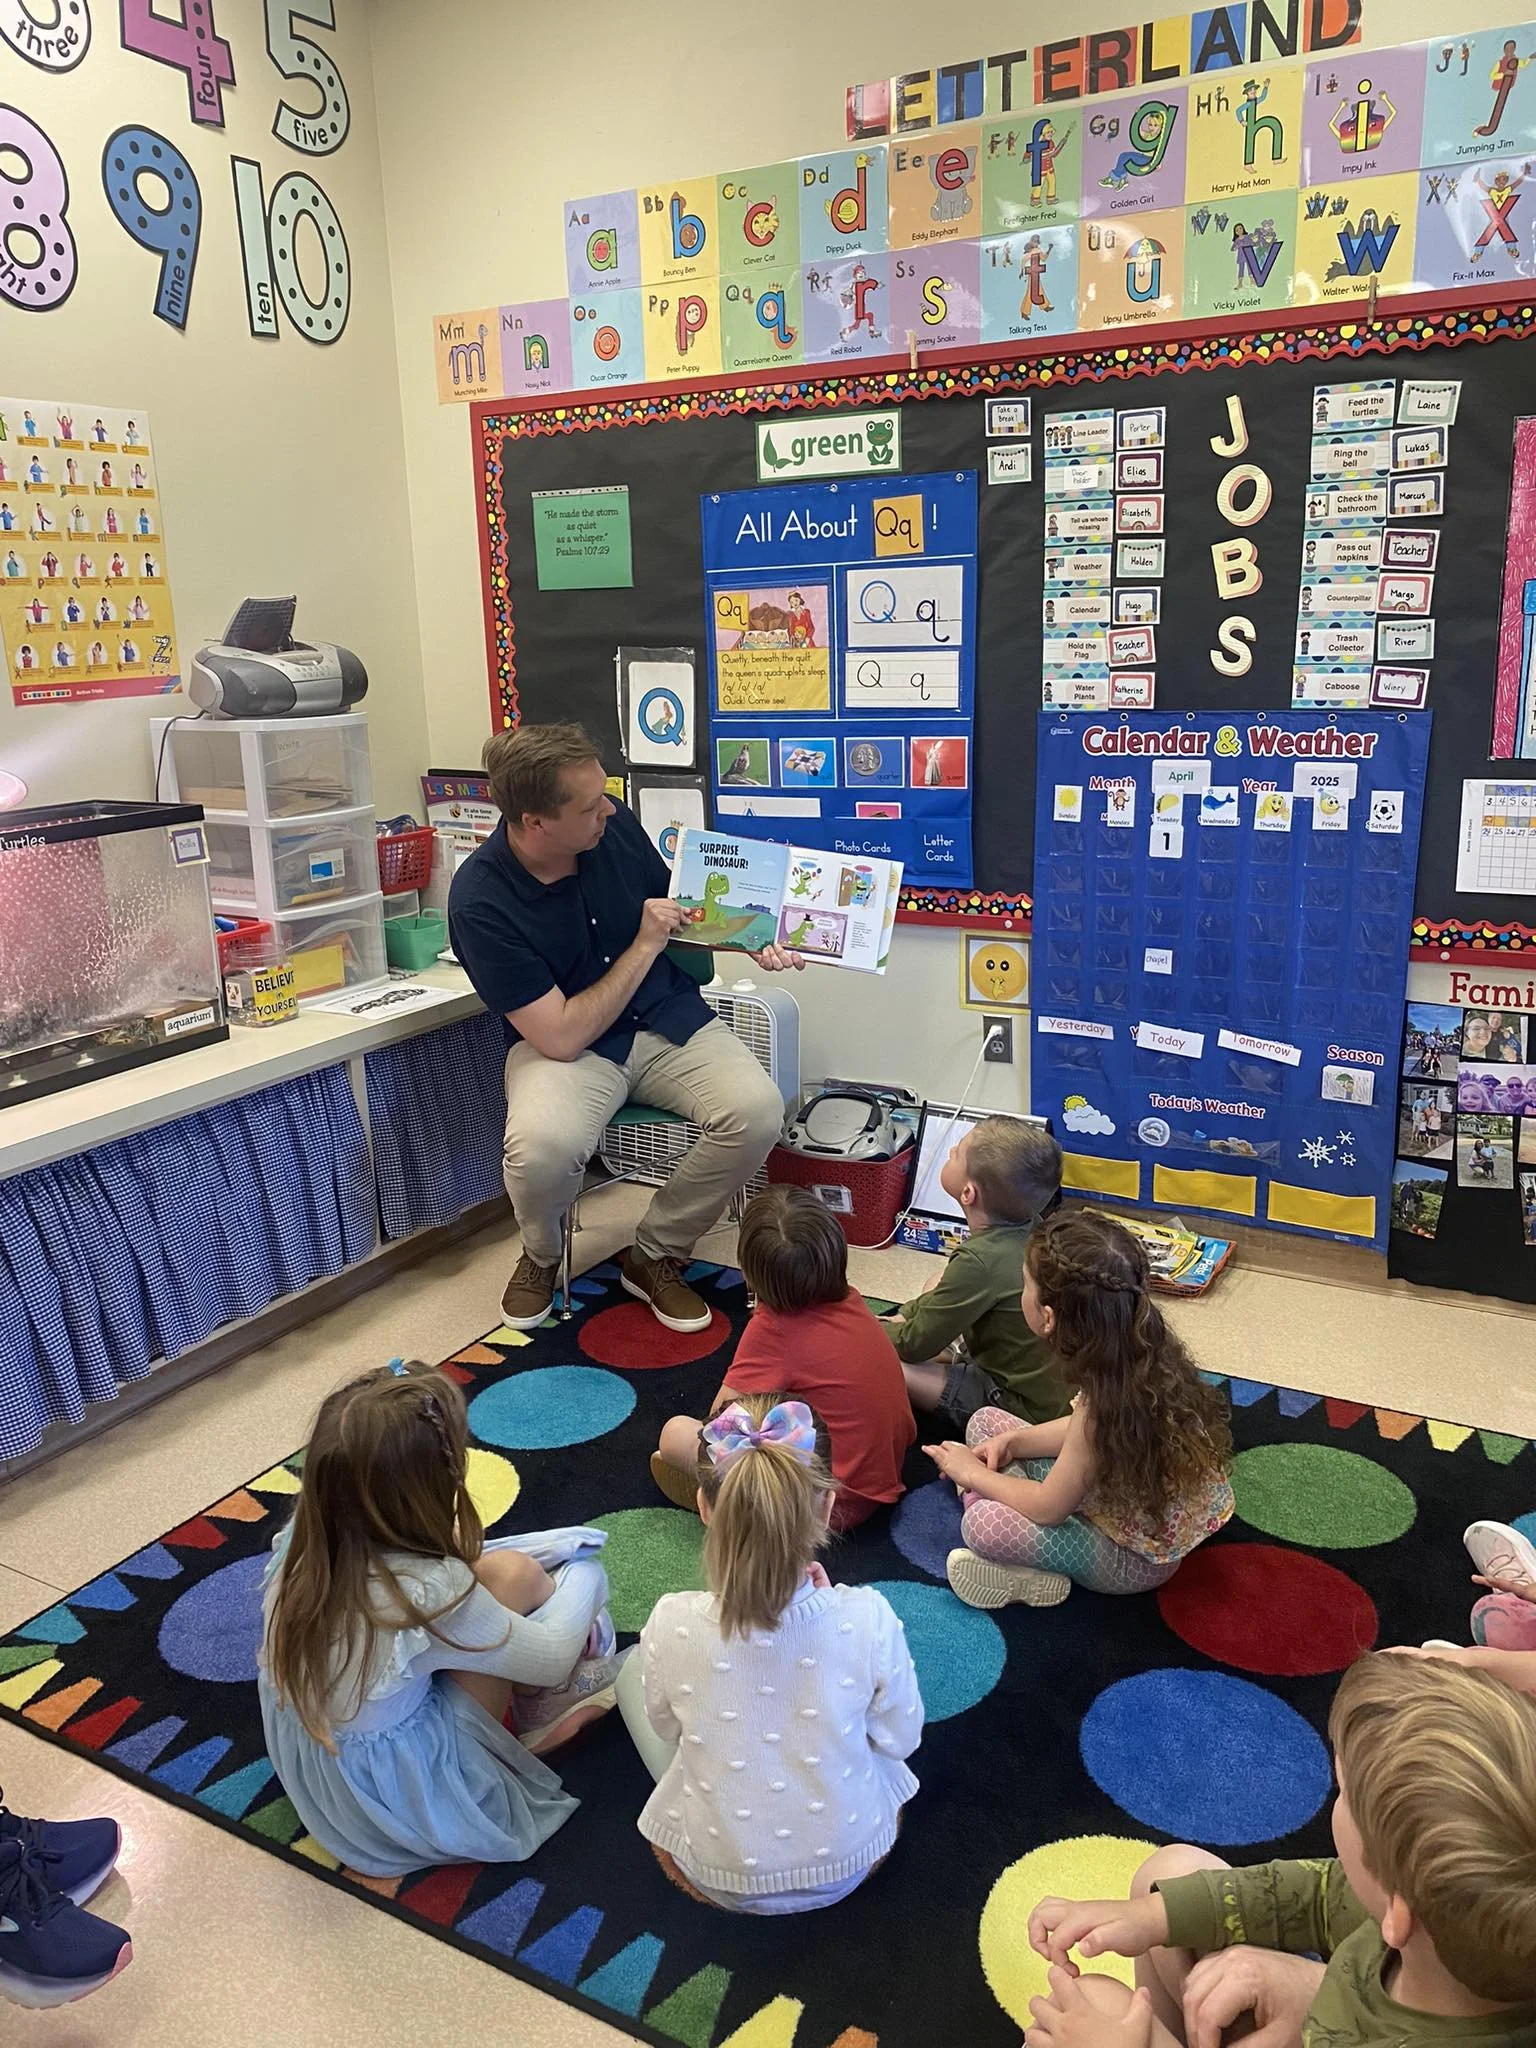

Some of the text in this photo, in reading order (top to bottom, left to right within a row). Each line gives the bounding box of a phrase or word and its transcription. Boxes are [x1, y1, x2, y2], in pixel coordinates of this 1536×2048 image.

[16, 19, 79, 59] three
[851, 0, 1362, 141] LETTERLAND
[197, 47, 216, 107] four
[294, 118, 328, 147] five
[1456, 139, 1514, 155] Jumping Jim
[1342, 160, 1377, 174] Impy Ink
[1212, 177, 1271, 193] Harry Hat Man
[1110, 195, 1155, 209] Golden Girl
[1040, 210, 1057, 220] Fred
[101, 124, 202, 332] 9
[912, 227, 958, 241] Eddy Elephant
[230, 154, 351, 346] 10
[826, 242, 862, 254] Dippy Duck
[743, 255, 775, 265] Clever Cat
[1452, 269, 1496, 282] Fix-it Max
[165, 265, 185, 317] nine
[1322, 288, 1349, 297] Walter
[257, 281, 272, 324] ten
[1213, 298, 1261, 312] Vicky Violet
[1103, 309, 1157, 325] Uppy Umbrella
[1009, 323, 1048, 336] Talking Tess
[936, 335, 957, 344] Snake
[831, 345, 862, 356] Red Robot
[772, 354, 793, 363] Queen
[607, 371, 628, 381] Orange
[1348, 398, 1368, 407] Feed
[1417, 400, 1440, 410] Laine
[1352, 408, 1379, 417] turtles
[1073, 427, 1108, 438] Line Leader
[1129, 423, 1150, 433] Porter
[791, 432, 863, 467] green
[1405, 443, 1429, 453] Lukas
[1334, 450, 1352, 459] Ring
[999, 460, 1017, 471] Andi
[1126, 465, 1146, 475] Elias
[1342, 460, 1357, 468] bell
[1337, 494, 1378, 503] Check the
[1399, 492, 1425, 500] Marcus
[559, 508, 618, 518] made the storm
[1121, 508, 1151, 517] Elizabeth
[1337, 504, 1377, 513] bathroom
[577, 521, 597, 533] quiet
[735, 511, 772, 545] All
[780, 504, 858, 543] About
[875, 507, 920, 549] Qq
[556, 547, 583, 557] Psalms
[1336, 543, 1355, 551] Pass
[1392, 542, 1427, 556] Teacher
[1130, 556, 1153, 566] Holden
[1337, 554, 1369, 562] napkins
[1074, 563, 1102, 571] Weather
[1326, 594, 1371, 602] Counterpillar
[1391, 589, 1415, 600] Margo
[860, 580, 896, 623] Q
[1125, 600, 1141, 613] Hugo
[717, 596, 747, 627] Qq
[1068, 642, 1096, 650] Hold the
[1114, 640, 1145, 651] Teacher
[1394, 637, 1416, 646] River
[1328, 644, 1364, 652] Collector
[752, 651, 794, 663] beneath the
[1074, 652, 1089, 660] Flag
[764, 666, 805, 681] quadruplets
[857, 660, 884, 689] Q
[1325, 682, 1360, 690] Caboose
[747, 695, 770, 705] Come
[1083, 724, 1376, 757] Calendar & Weather
[1089, 776, 1135, 790] Month
[1168, 771, 1194, 783] April
[1310, 776, 1339, 786] 2025
[426, 783, 454, 797] LOS
[1242, 778, 1276, 793] Year
[1156, 816, 1179, 824] Tuesday
[1202, 817, 1235, 825] Wednesday
[1259, 821, 1286, 829] Thursday
[1321, 821, 1340, 829] Friday
[1370, 823, 1400, 831] Saturday
[835, 839, 892, 854] Photo Cards
[923, 834, 954, 847] Letter
[1162, 832, 1170, 851] 1
[699, 843, 739, 858] SURPRISE
[925, 850, 954, 862] Cards
[704, 856, 749, 870] DINOSAUR!
[276, 992, 283, 1000] in
[257, 998, 297, 1017] YOURSEL
[167, 1011, 211, 1031] aquarium
[1048, 1018, 1106, 1035] Yesterday
[1150, 1032, 1186, 1050] Today
[1232, 1032, 1290, 1056] Tomorrow
[1328, 1045, 1383, 1065] Season
[1151, 1095, 1264, 1118] Today's Weather
[903, 1227, 917, 1239] 24
